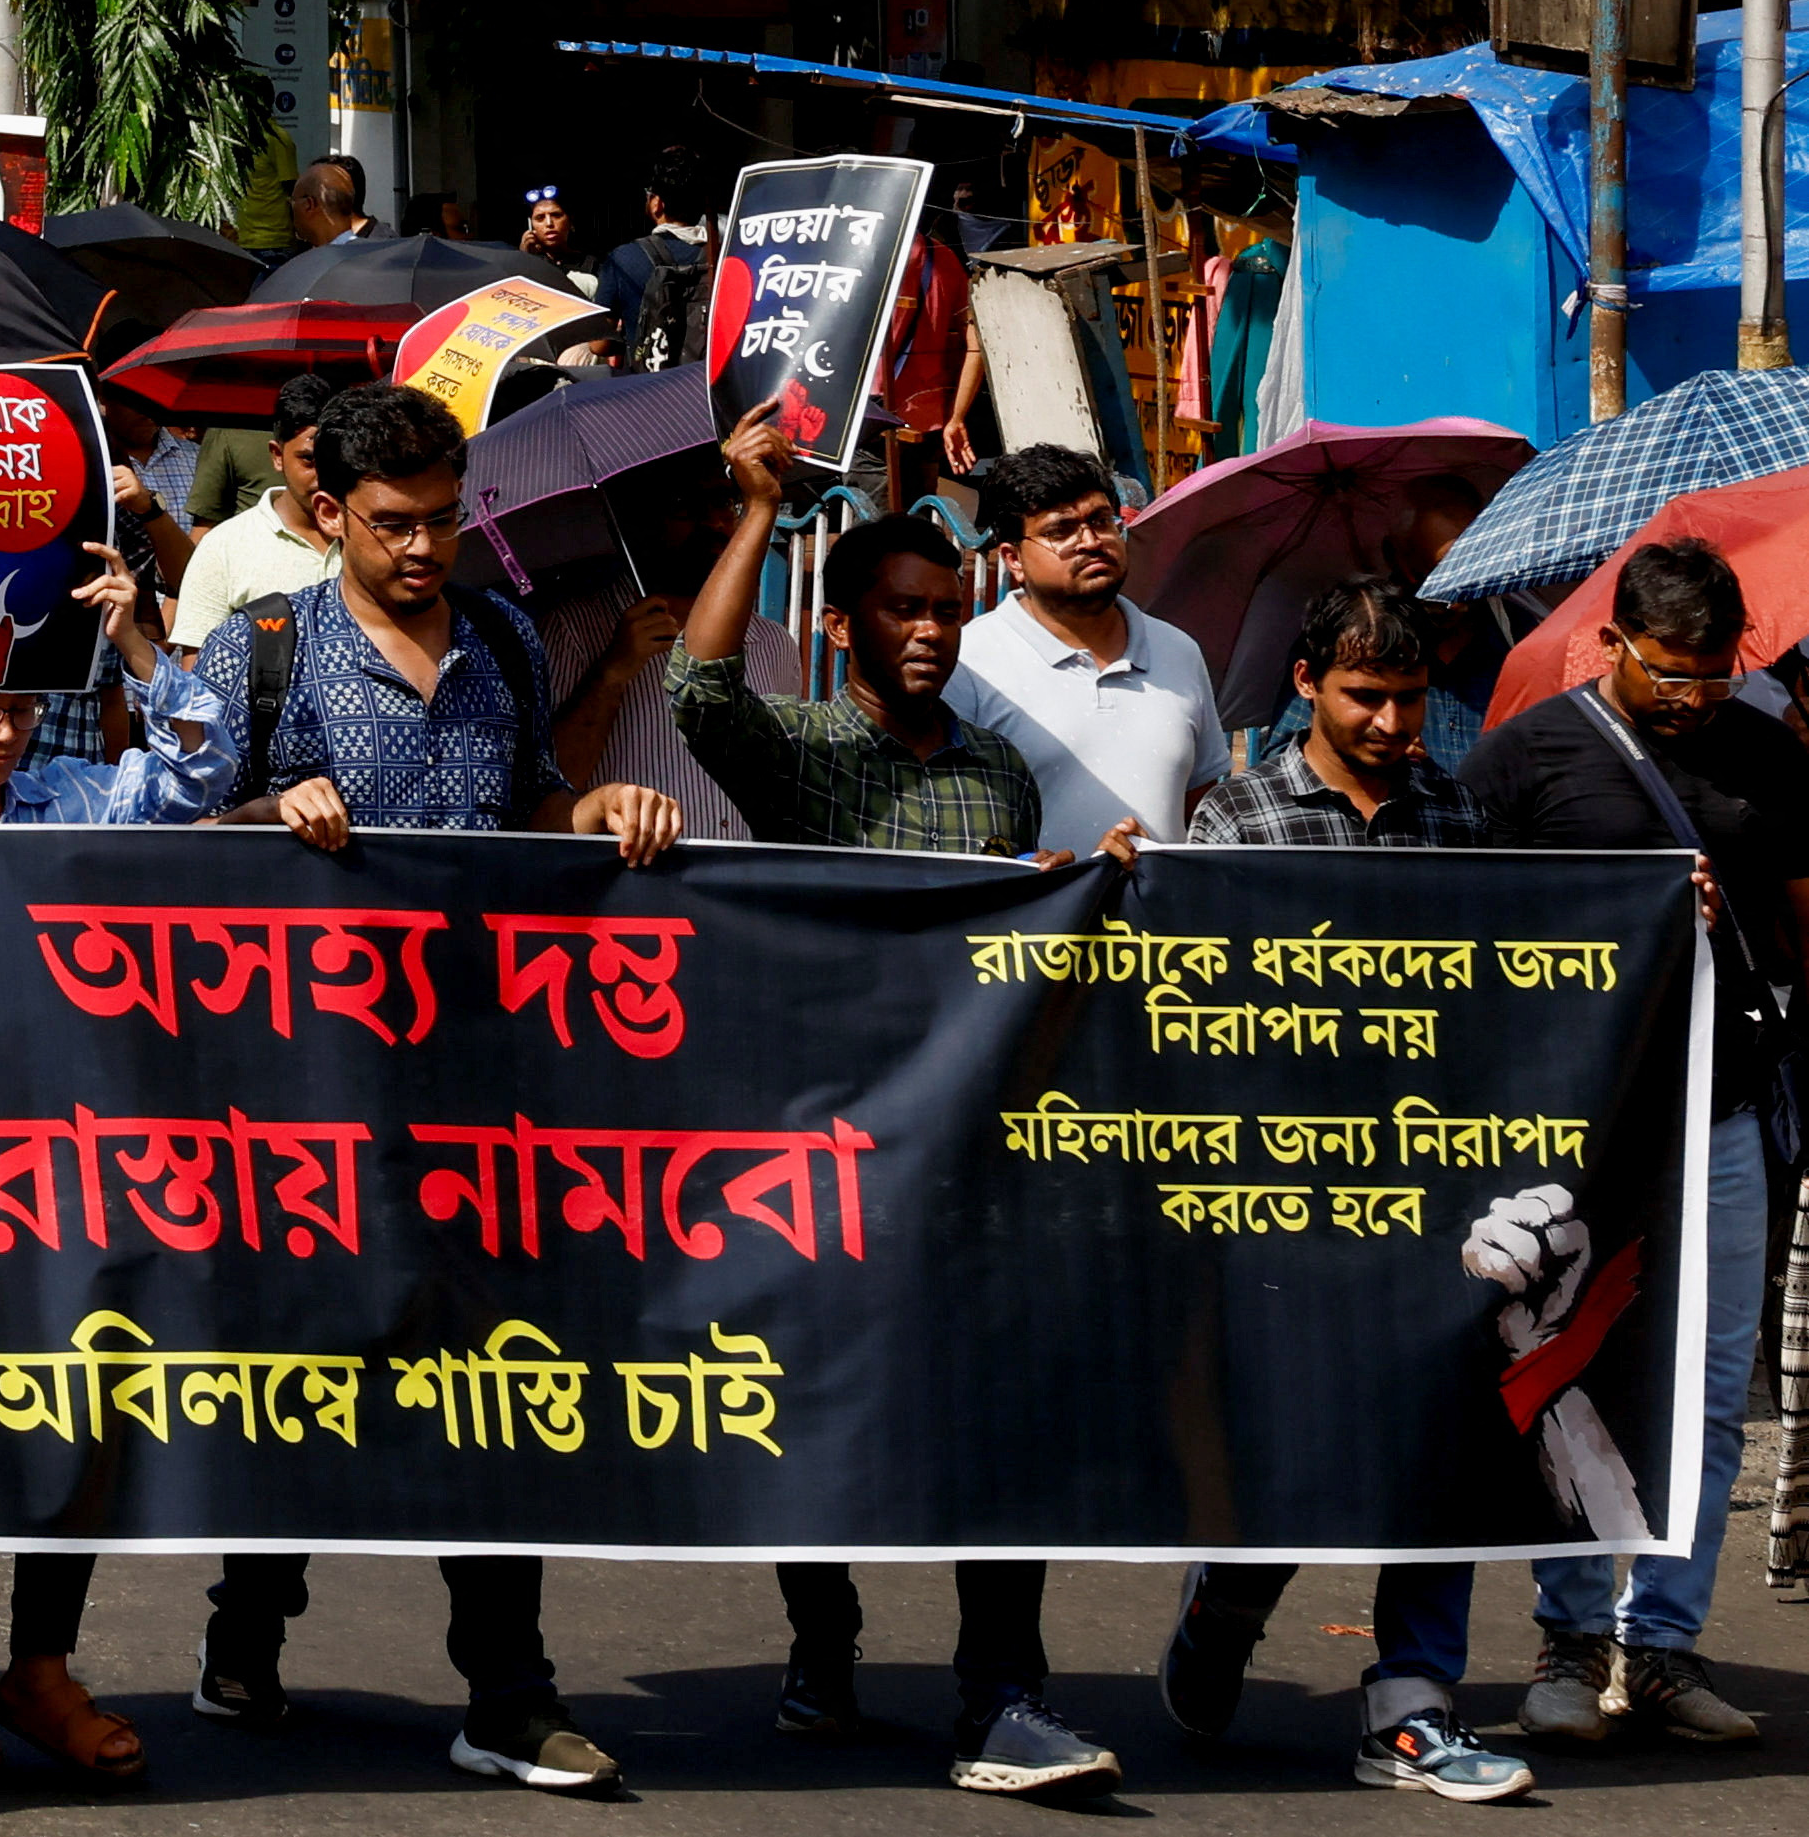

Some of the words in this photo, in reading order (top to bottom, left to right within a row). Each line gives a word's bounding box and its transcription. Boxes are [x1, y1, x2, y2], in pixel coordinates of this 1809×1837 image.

[738, 203, 886, 248] অভয়া'র
[754, 254, 863, 304] বিচার
[740, 307, 811, 358] চাই
[426, 371, 463, 399] করতে
[27, 903, 449, 1046] অসহ্য
[483, 913, 695, 1059] দম্ভ
[966, 917, 1230, 985] রাজ্যটাকে
[1252, 921, 1478, 991] ধর্ষকদের
[1494, 940, 1620, 992] জন্য
[1146, 982, 1342, 1059] নিরাপদ
[1359, 1006, 1439, 1061] নয়
[1000, 1090, 1242, 1164] মহিলাদের
[1258, 1116, 1381, 1168] জন্য
[1393, 1095, 1589, 1169] নিরাপদ
[410, 1112, 876, 1263] নামবো
[1158, 1185, 1313, 1237] করতে
[1327, 1186, 1427, 1237] হবে
[389, 1320, 589, 1455] শাস্তি
[615, 1321, 784, 1458] চাই
